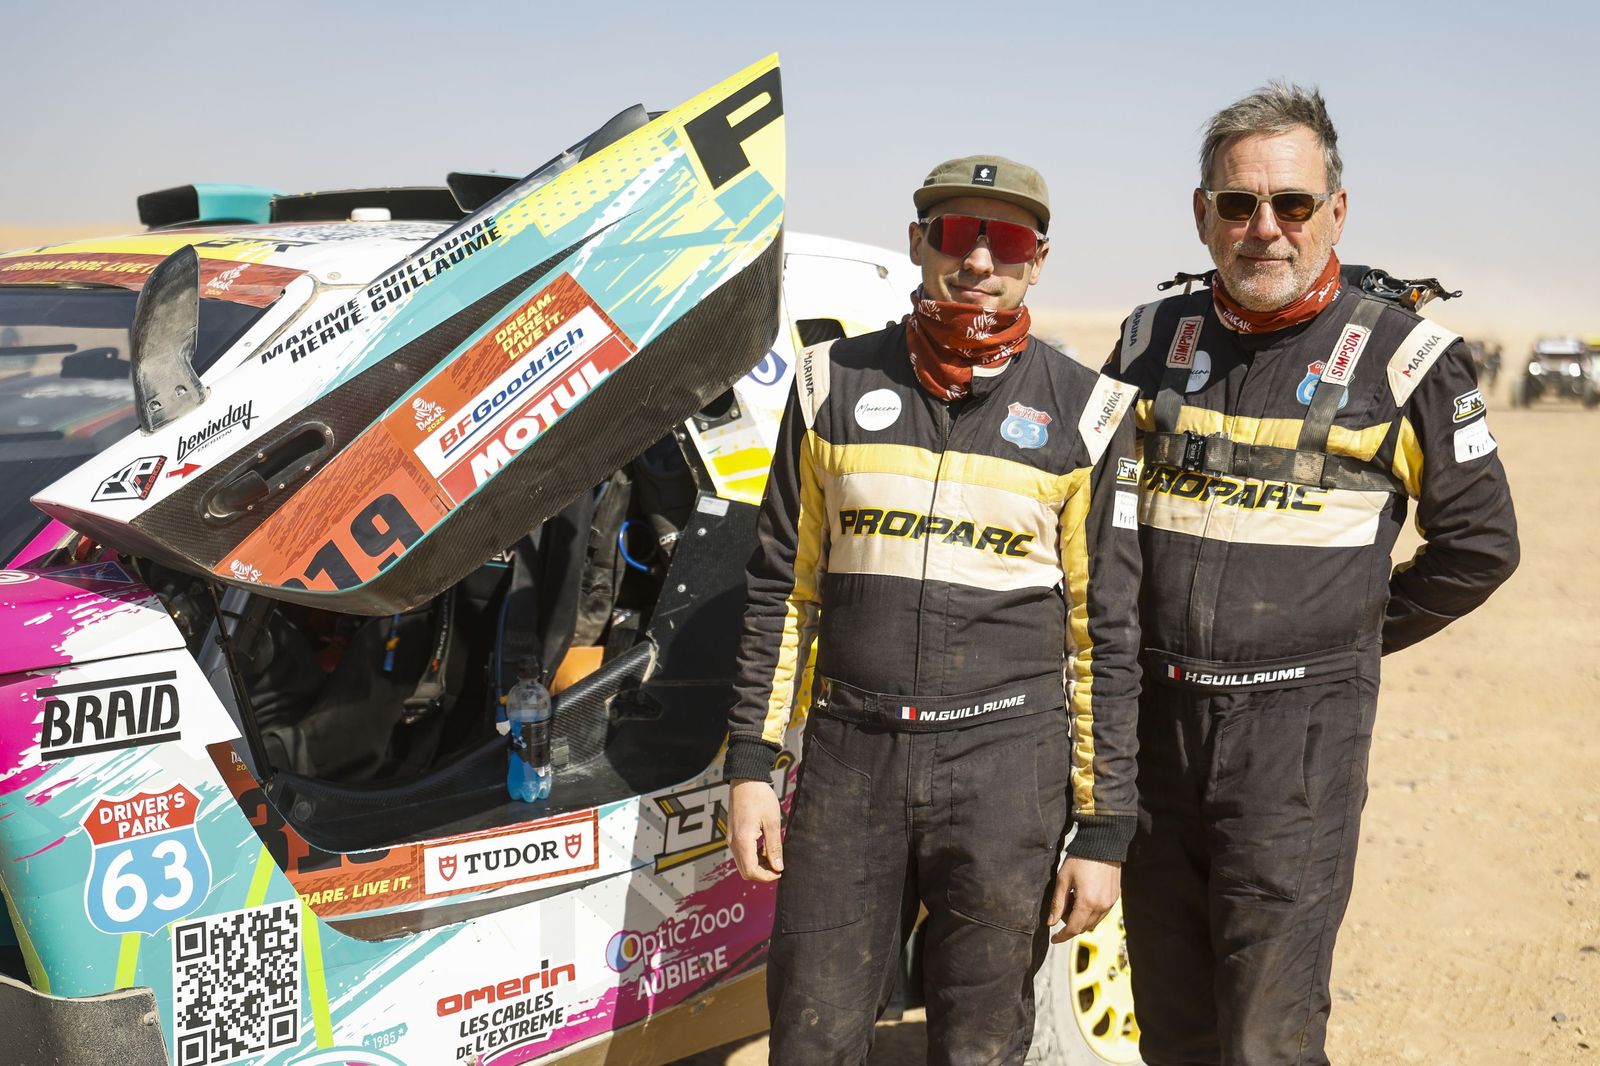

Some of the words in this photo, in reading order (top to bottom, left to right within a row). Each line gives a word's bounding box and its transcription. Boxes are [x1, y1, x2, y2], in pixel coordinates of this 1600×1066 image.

[684, 67, 784, 190] P
[261, 297, 359, 364] MAXIME
[367, 215, 496, 299] GUILLAUME
[371, 225, 503, 313] GUILLAUME
[494, 293, 557, 345] DREAM.
[501, 313, 549, 352] DARE.
[508, 325, 545, 361] LIVE
[546, 310, 565, 331] IT.
[1174, 322, 1198, 362] SIMPSON
[802, 350, 815, 397] MARINA
[1331, 331, 1362, 377] SIMPSON
[1402, 334, 1441, 379] MARINA
[438, 326, 585, 453] BFGoodrich
[1093, 391, 1123, 434] MARINA
[416, 406, 447, 431] DAKAR
[470, 360, 610, 487] MOTUL
[1007, 420, 1040, 444] 63
[839, 508, 1035, 558] PROPARC
[1185, 667, 1306, 686] H.GUILLAUME
[40, 683, 180, 749] BRAID
[919, 694, 1026, 721] M.GUILLAUME
[99, 792, 186, 825] DRIVER'S
[118, 812, 171, 839] PARK
[102, 839, 194, 923] 63
[464, 840, 559, 875] TUDOR
[352, 879, 391, 898] LIVE
[393, 876, 412, 891] IT.
[620, 921, 687, 964] Optic
[689, 902, 745, 941] 2000
[436, 959, 576, 1017] omerin
[456, 1043, 473, 1060] DE
[475, 1007, 564, 1053] L'EXTREME
[460, 1013, 489, 1038] LES
[492, 991, 553, 1026] CABLES
[373, 1031, 396, 1049] 1985
